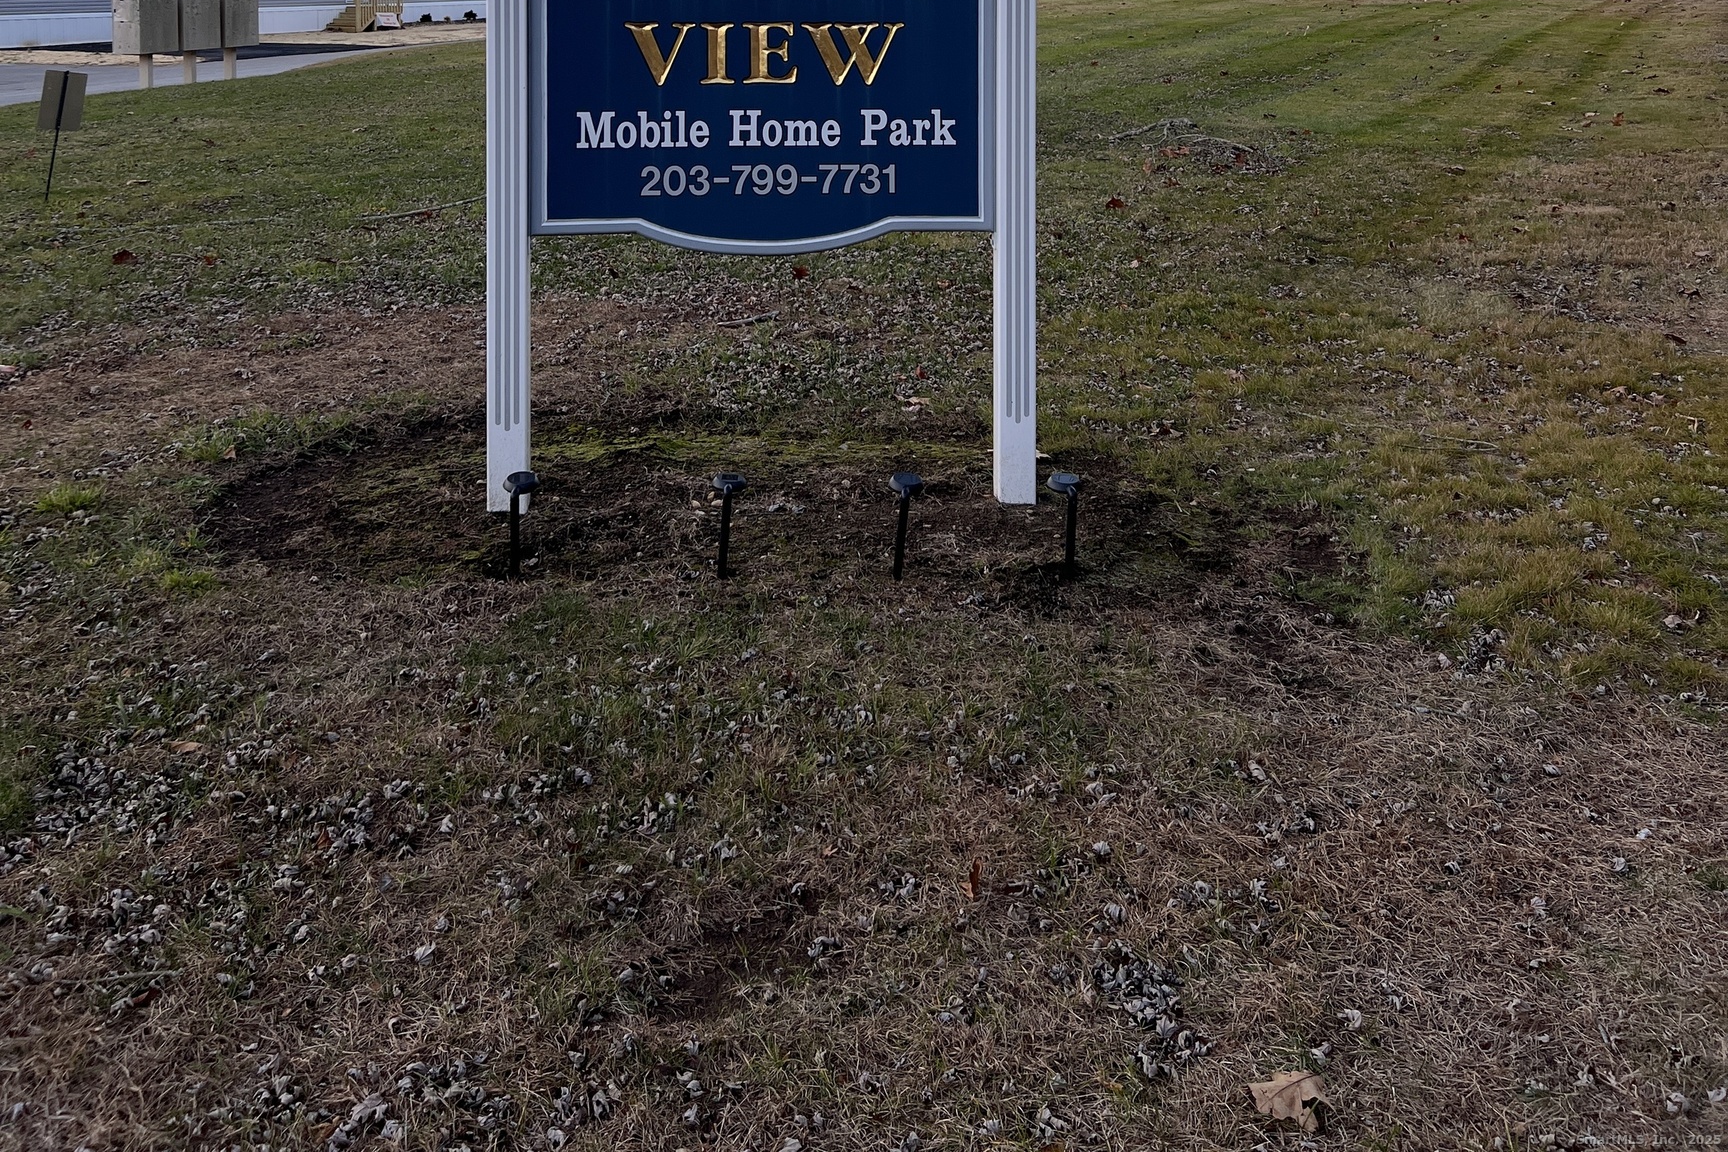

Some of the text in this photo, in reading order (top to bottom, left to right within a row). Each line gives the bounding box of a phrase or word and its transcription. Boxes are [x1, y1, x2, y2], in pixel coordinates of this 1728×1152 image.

[624, 22, 905, 86] VIEW
[576, 109, 957, 149] Mobile Home Park
[640, 163, 897, 196] 203-799-7731
